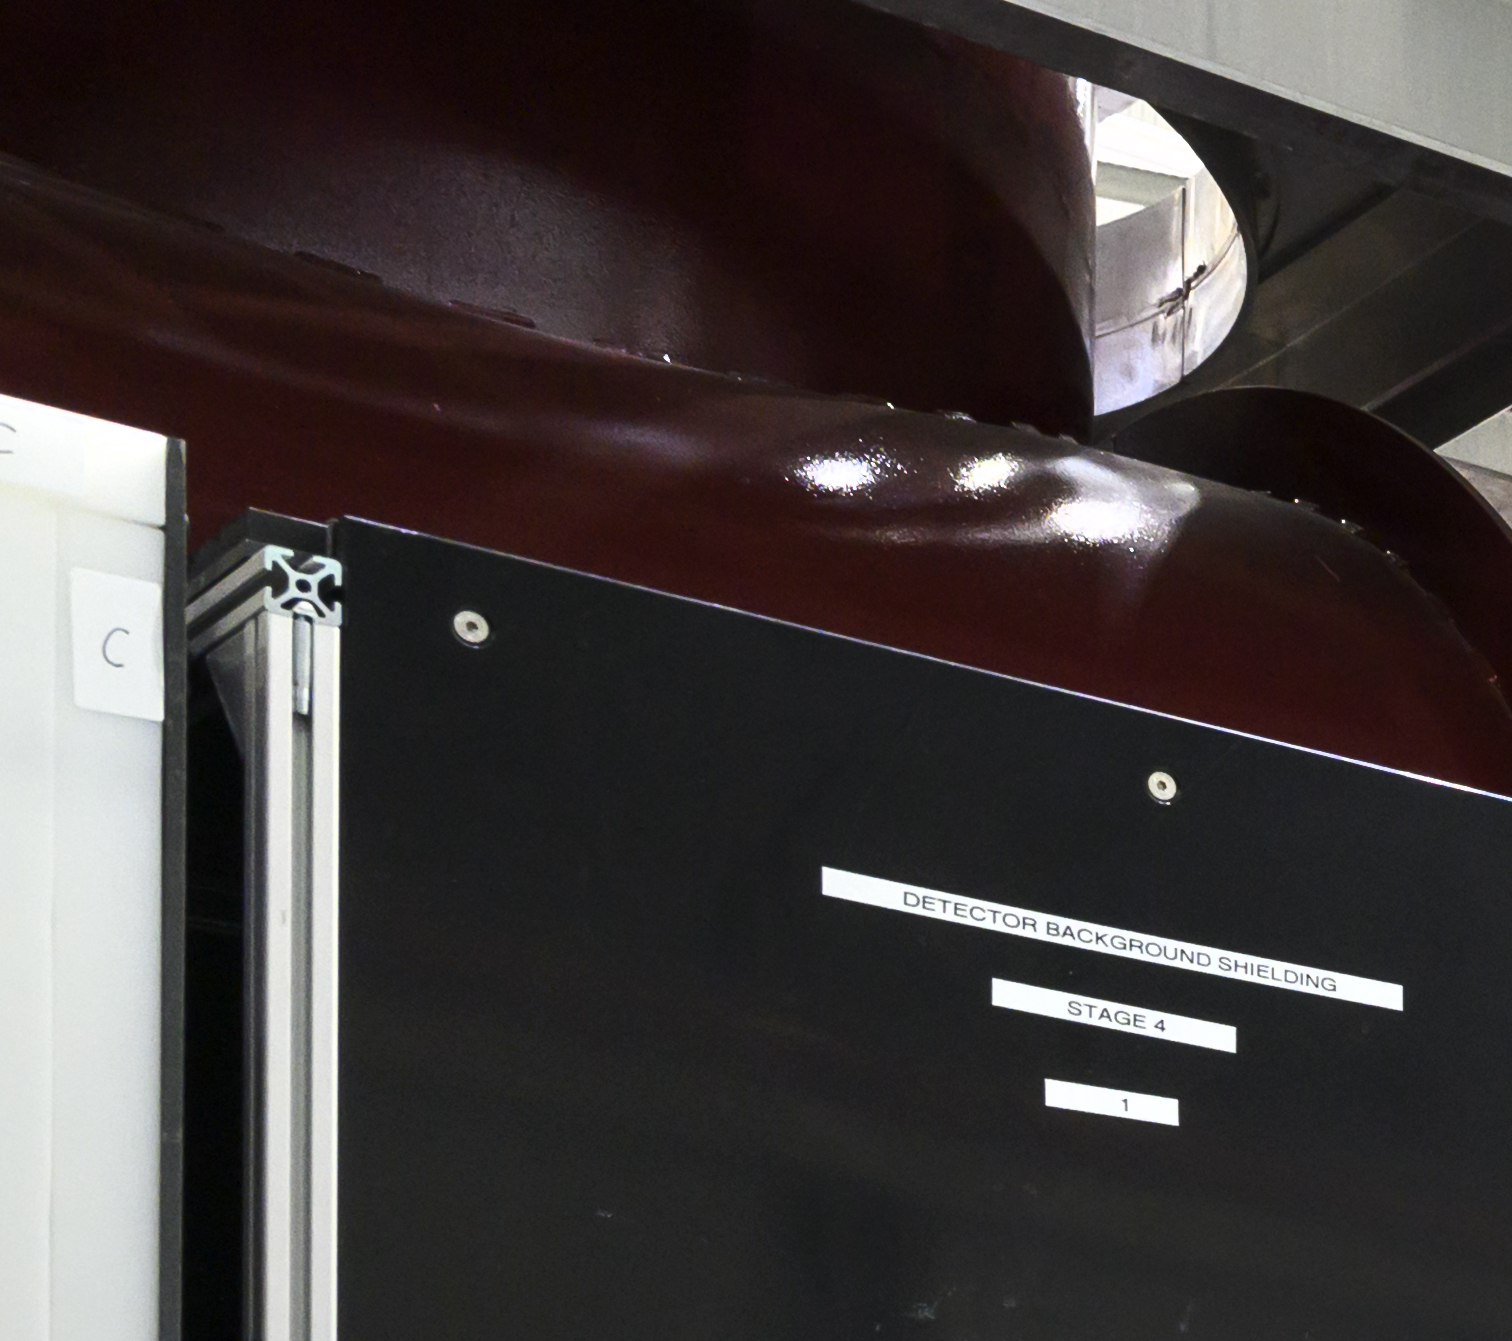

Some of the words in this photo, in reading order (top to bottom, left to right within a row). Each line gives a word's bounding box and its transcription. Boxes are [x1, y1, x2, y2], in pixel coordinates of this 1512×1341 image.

[101, 627, 130, 668] C
[903, 891, 1037, 932] DETECTOR
[1046, 921, 1211, 967] BACKGROUND
[1218, 956, 1337, 992] SHIELDING
[1067, 1000, 1147, 1029] STAGE
[1154, 1018, 1167, 1033] 4
[1122, 1097, 1129, 1112] 1
